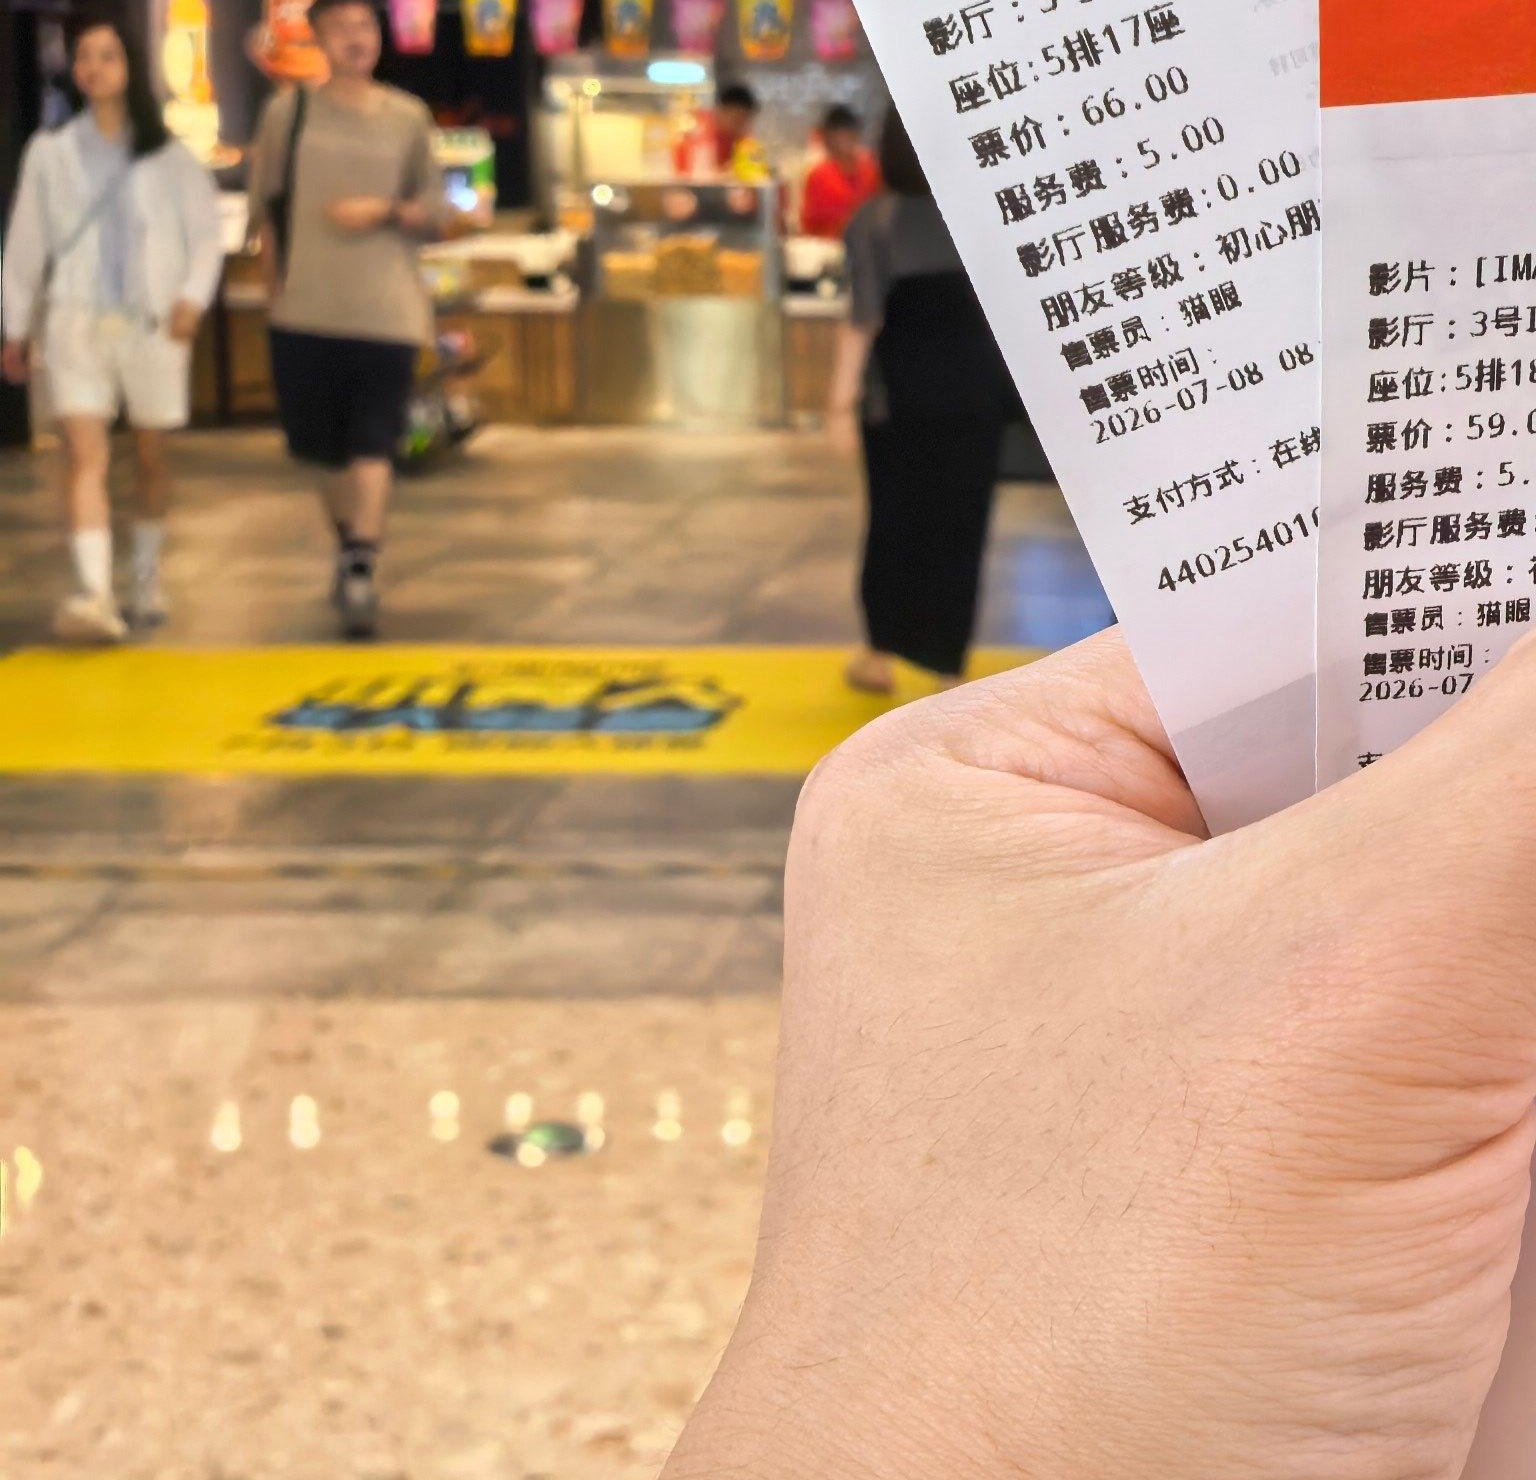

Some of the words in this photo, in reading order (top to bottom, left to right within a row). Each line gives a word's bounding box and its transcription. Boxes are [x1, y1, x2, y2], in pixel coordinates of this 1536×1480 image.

[967, 66, 1189, 169] 票价：66.00
[994, 116, 1225, 226] 服务费：5.00
[1016, 151, 1301, 279] 影厅服务费:0.00
[1039, 199, 1321, 332] 朋友等级：初心朋
[1088, 361, 1264, 445] 2026-07-08
